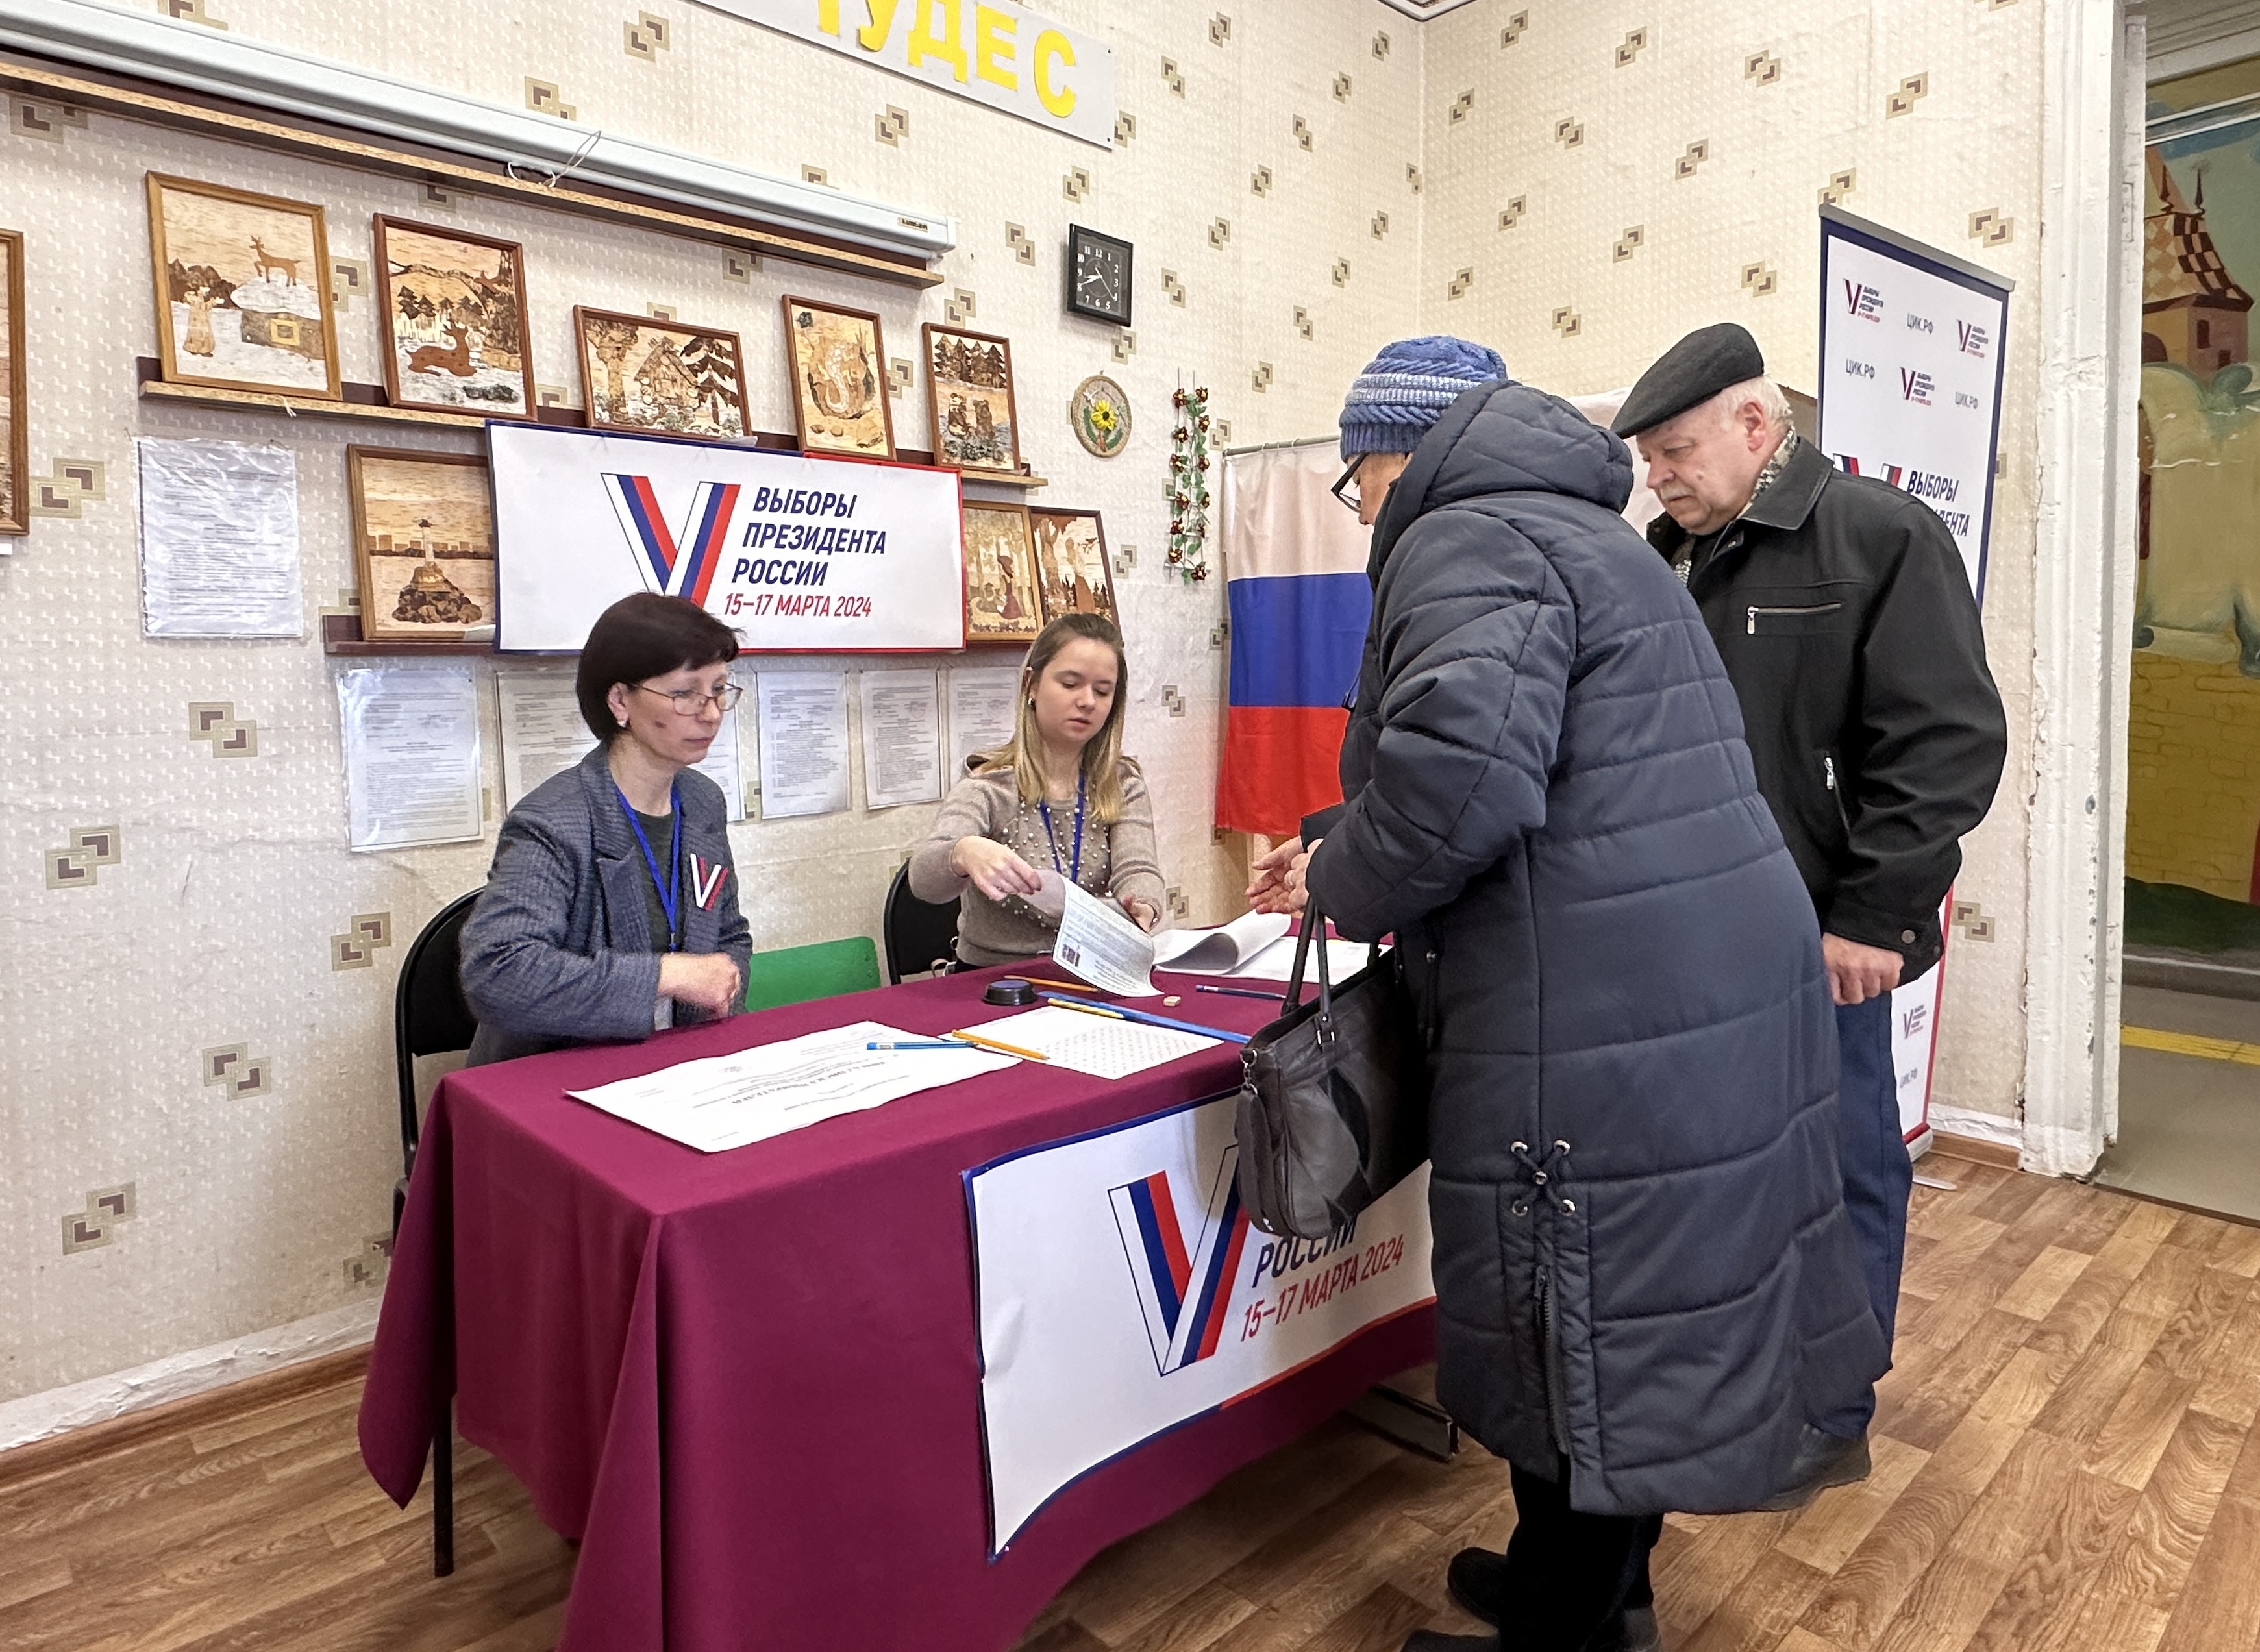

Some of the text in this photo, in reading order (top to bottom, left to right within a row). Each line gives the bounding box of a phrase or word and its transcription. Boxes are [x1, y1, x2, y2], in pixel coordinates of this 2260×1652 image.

[1095, 248, 1102, 258] 12
[1107, 253, 1111, 262] 1
[1077, 267, 1082, 277] 9
[1114, 264, 1119, 273] 2
[1114, 278, 1119, 287] 3
[1085, 295, 1090, 304] 7
[1095, 299, 1100, 308] 6
[1106, 301, 1111, 310] 5
[1907, 470, 1959, 502] ВЫБОРЫ
[752, 486, 858, 519] ВЫБОРЫ
[742, 522, 886, 556] ПРЕЗИДЕНТА
[731, 558, 829, 586] РОССИИ
[774, 594, 831, 617] МАРТА
[833, 595, 873, 617] 2024
[1298, 1253, 1359, 1315] МАРТА
[1360, 1233, 1404, 1283] 2024
